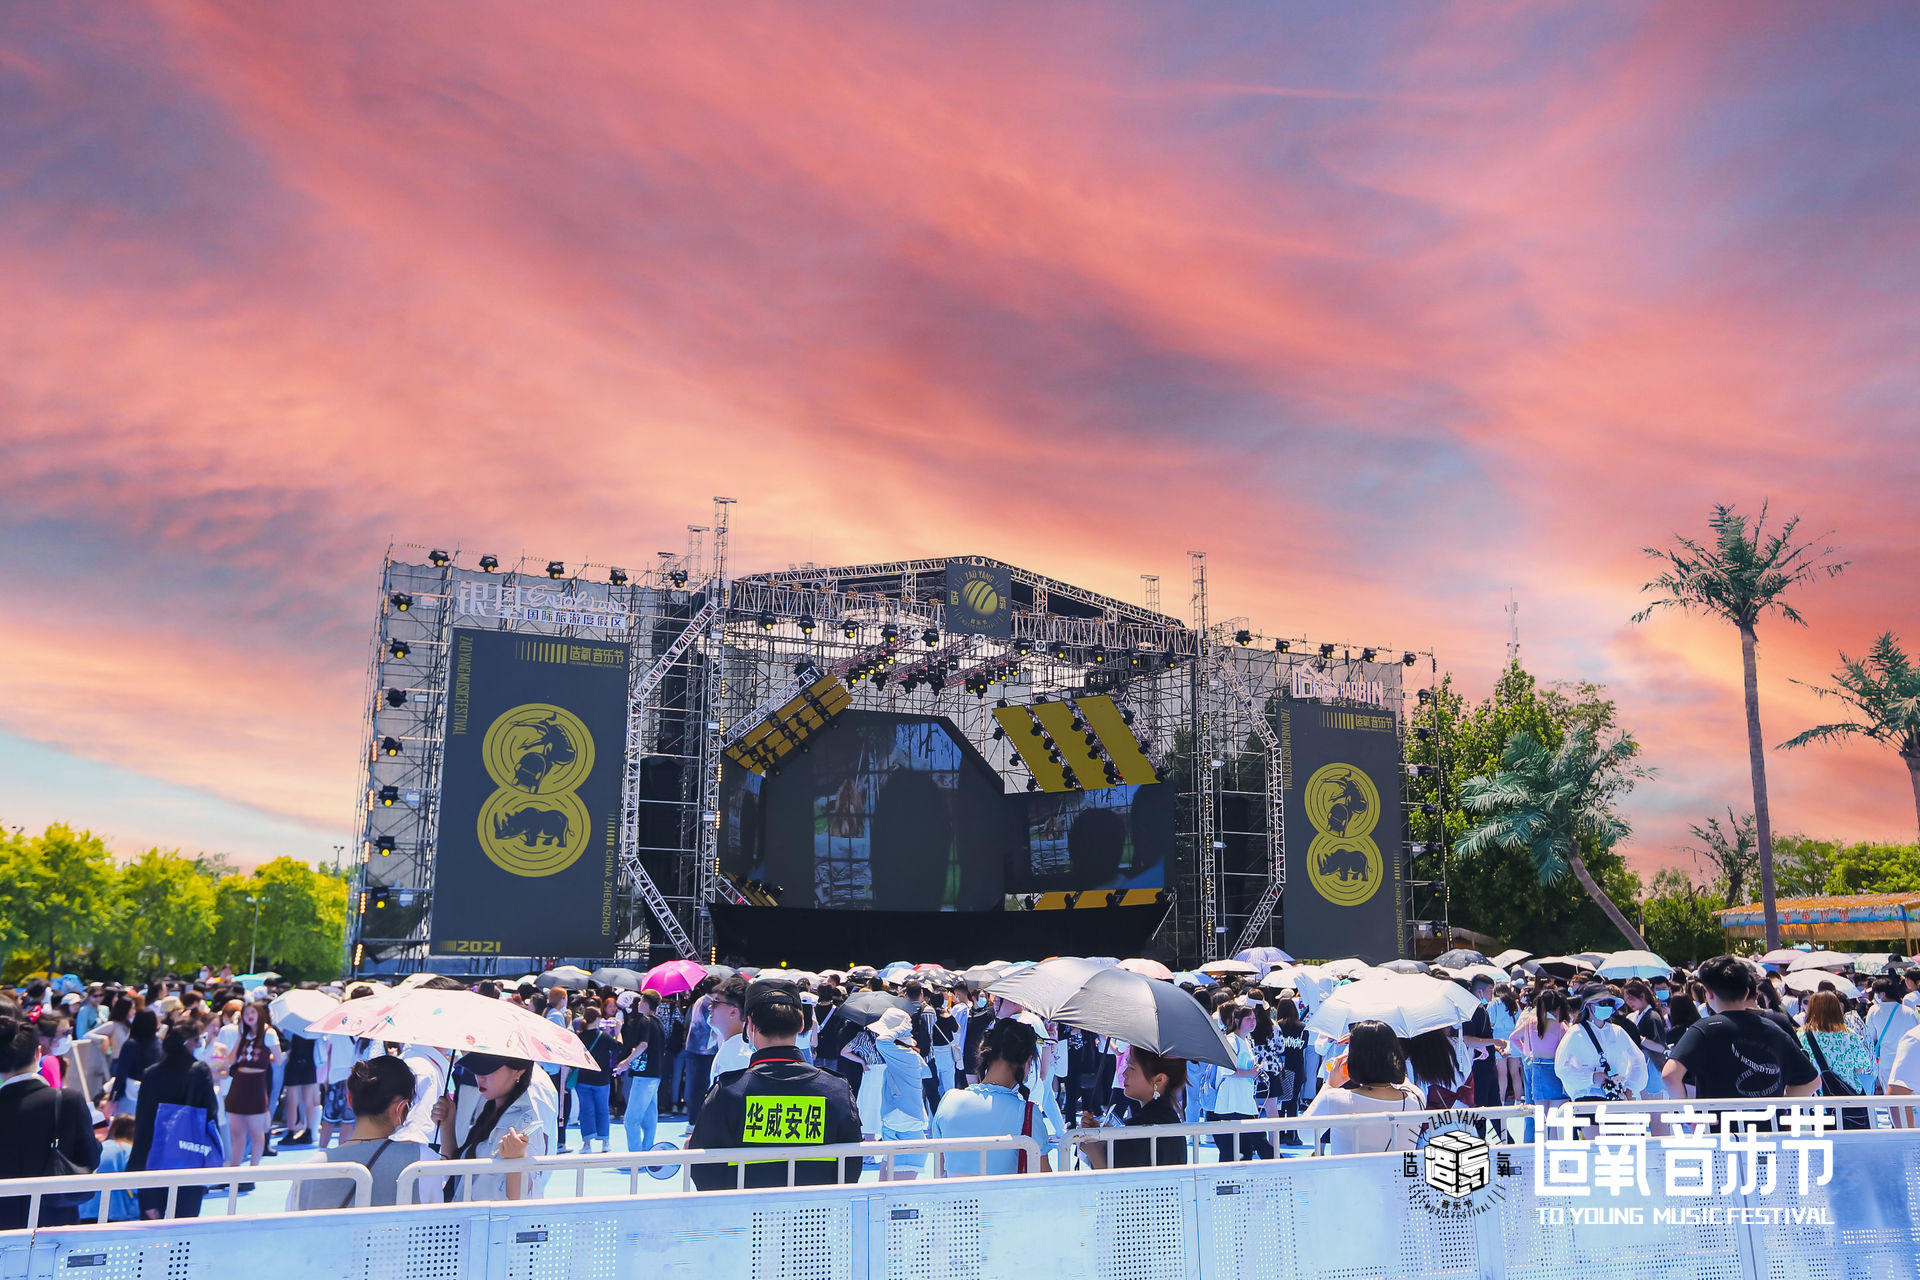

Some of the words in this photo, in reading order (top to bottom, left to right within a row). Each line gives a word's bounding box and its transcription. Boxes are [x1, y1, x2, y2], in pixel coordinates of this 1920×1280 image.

[527, 608, 622, 628] 国际旅游度假区
[570, 645, 624, 664] 造氧音乐节
[1340, 681, 1384, 706] HARBIN
[604, 849, 615, 877] CHINA
[601, 881, 612, 936] ZHENGZHOU
[457, 940, 501, 953] 2021
[746, 1102, 822, 1139] 华威安保
